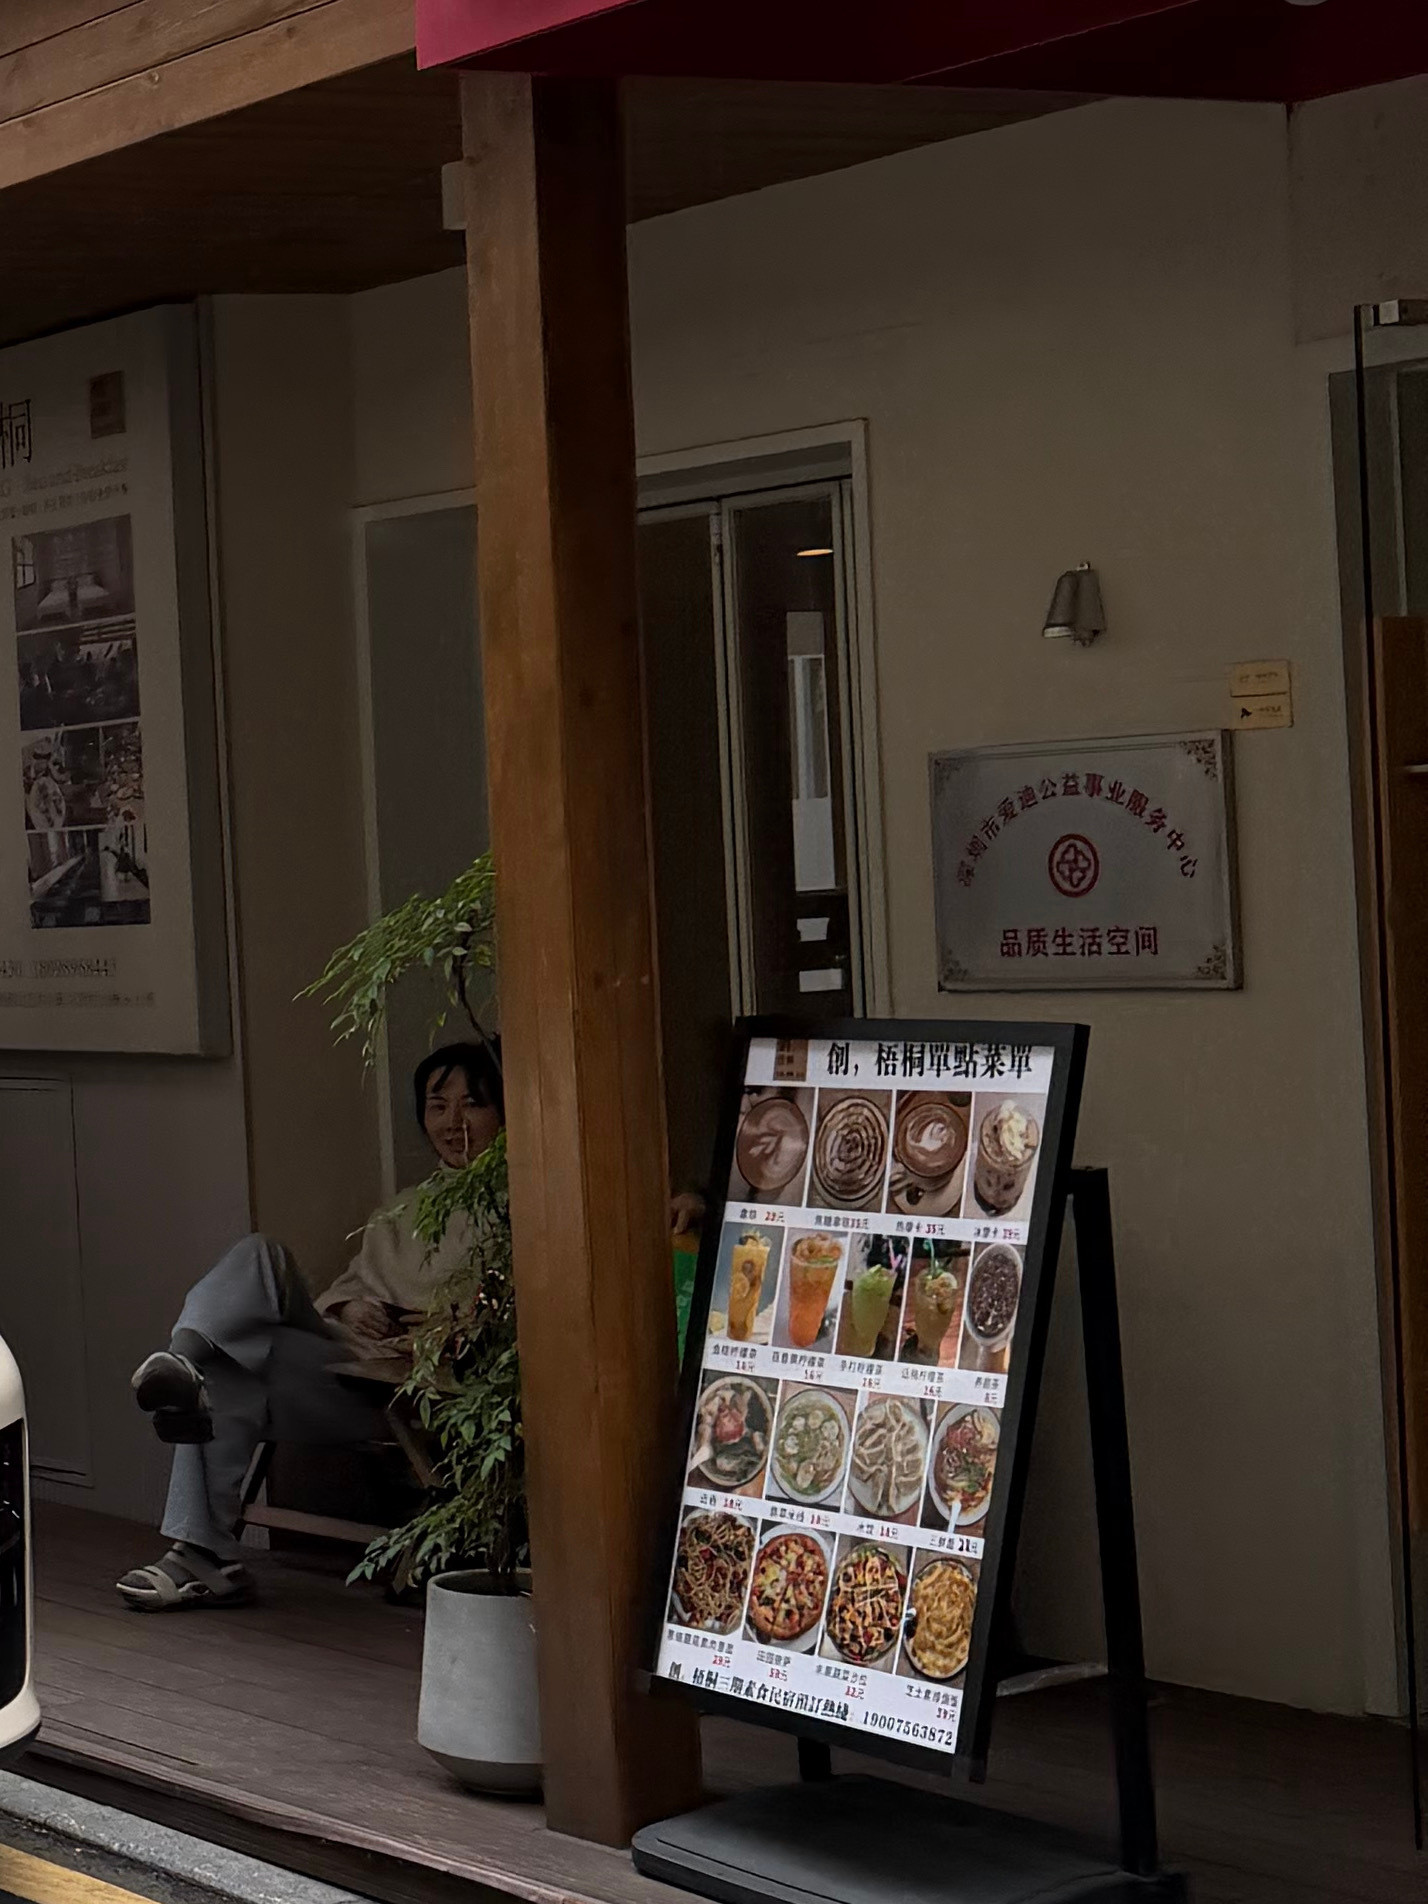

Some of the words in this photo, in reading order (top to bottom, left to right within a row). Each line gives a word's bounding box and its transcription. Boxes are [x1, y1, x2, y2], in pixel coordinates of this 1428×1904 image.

[999, 925, 1160, 957] 品质生活空间
